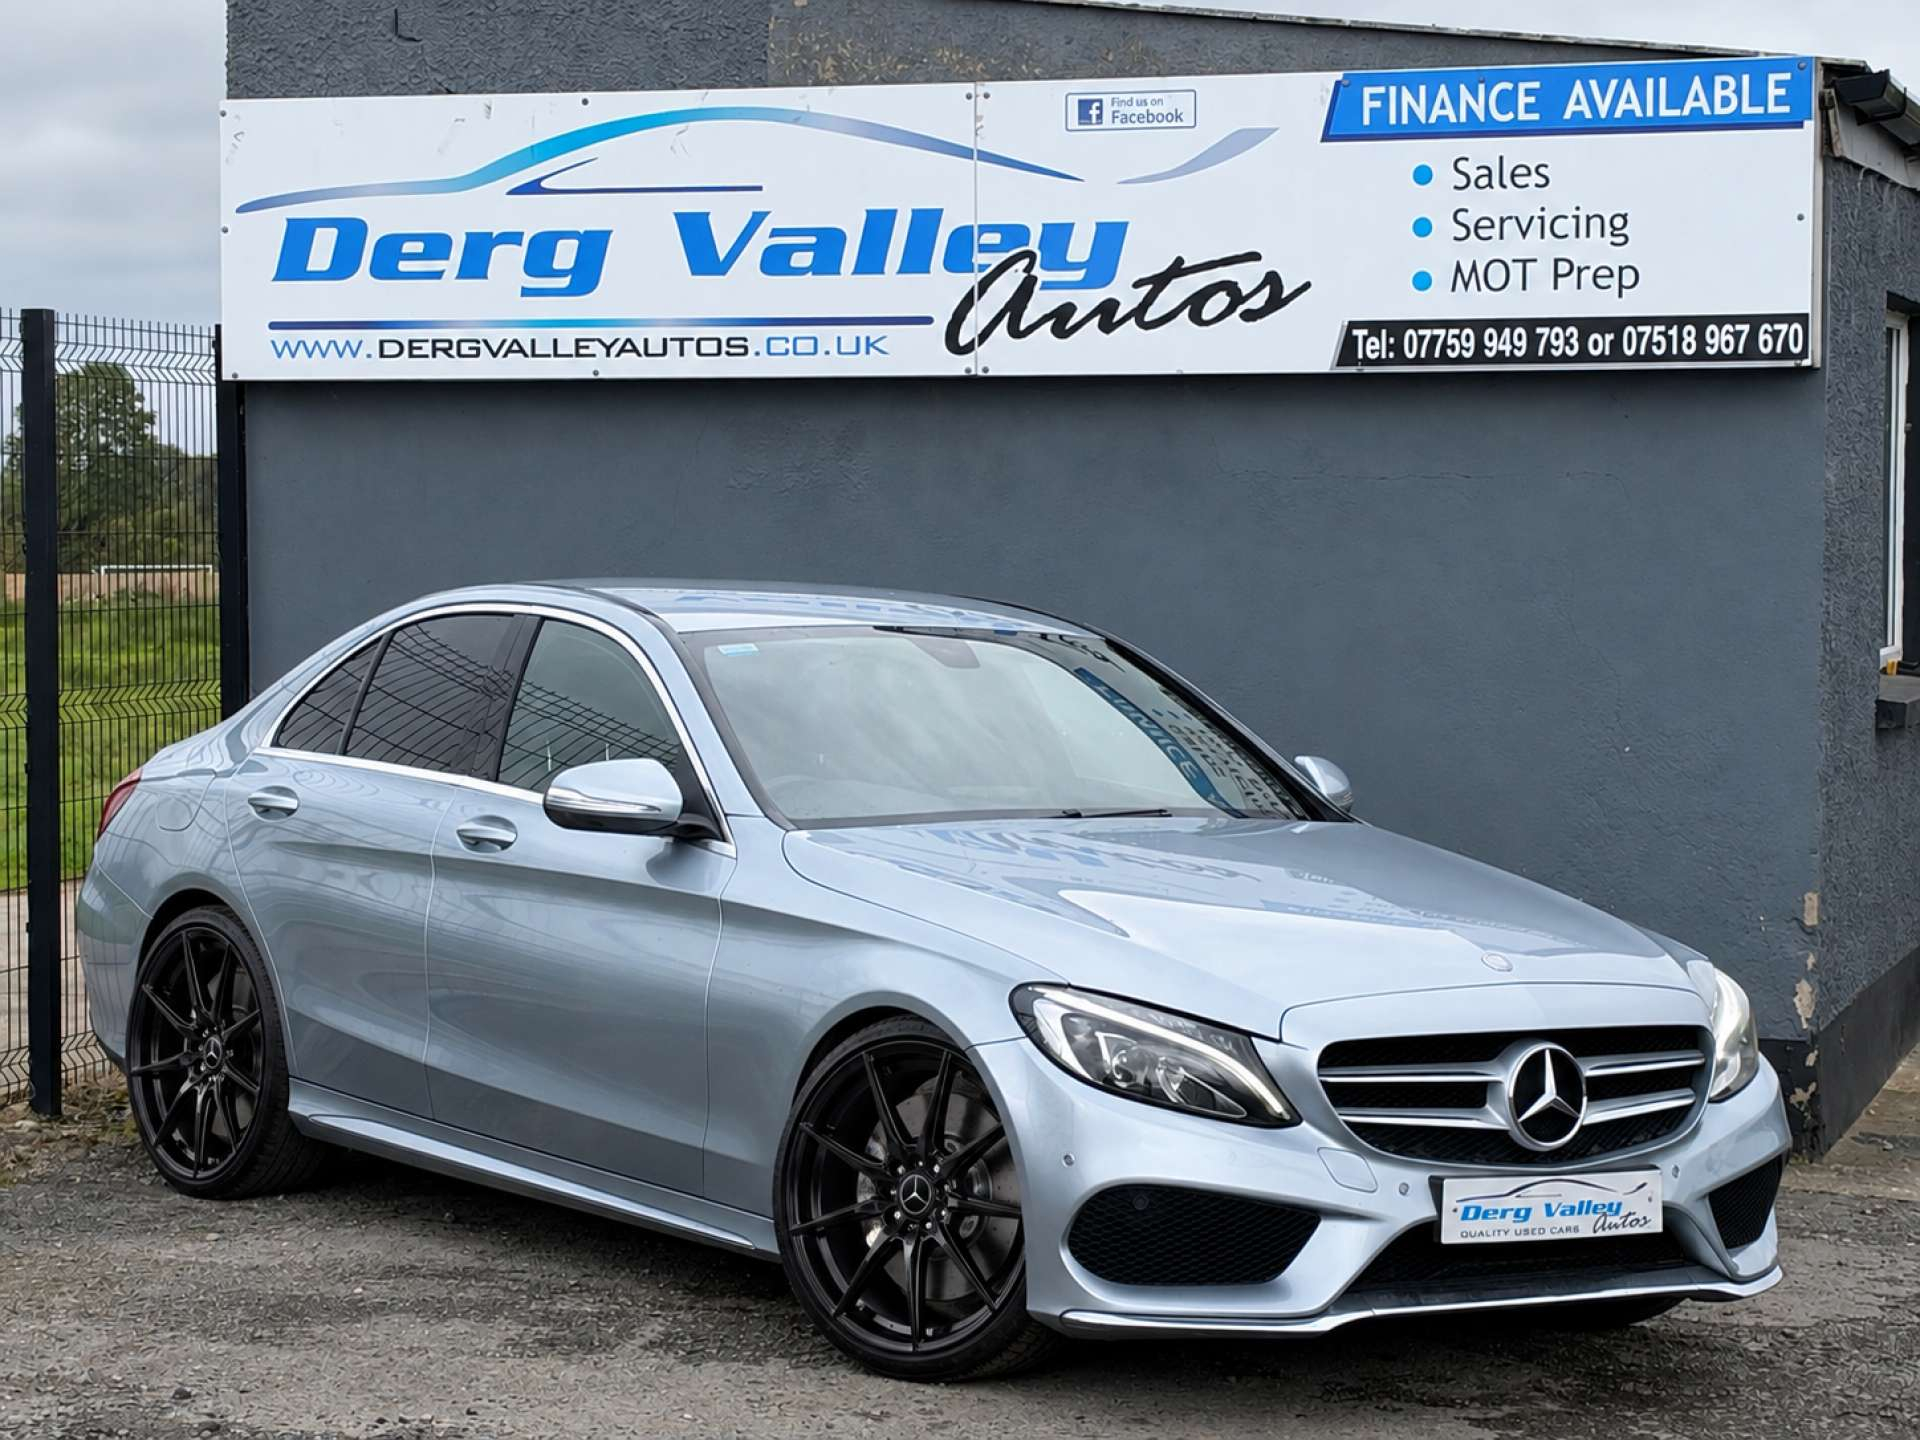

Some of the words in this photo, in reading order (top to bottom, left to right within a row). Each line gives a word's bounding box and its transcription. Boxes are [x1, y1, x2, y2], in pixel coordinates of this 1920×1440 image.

[1111, 97, 1133, 107] Find
[1136, 98, 1148, 107] us
[1150, 98, 1164, 106] on
[1111, 108, 1184, 124] Facebook
[1363, 81, 1541, 125] FINANCE
[1563, 72, 1792, 119] AVAILABLE
[1453, 155, 1550, 191] Sales
[1452, 206, 1630, 247] Servicing
[271, 217, 613, 298] Derg
[673, 207, 1129, 291] Valley
[1451, 258, 1538, 293] MOT
[1553, 257, 1641, 299] Prep
[944, 249, 1312, 355] Autos
[1352, 329, 1396, 360] Tel:
[1403, 328, 1475, 358] 07759
[1483, 327, 1527, 358] 949
[1535, 326, 1580, 356] 793
[1587, 332, 1615, 356] or
[1622, 325, 1697, 356] 07518
[1705, 324, 1751, 355] 967
[1758, 324, 1803, 354] 670
[1460, 1204, 1532, 1223] Derg
[1544, 1200, 1623, 1217] Valley
[1592, 1212, 1652, 1234] Autos
[1460, 1228, 1510, 1239] QUALITY
[1514, 1226, 1546, 1236] USED
[1549, 1224, 1580, 1235] CARS
